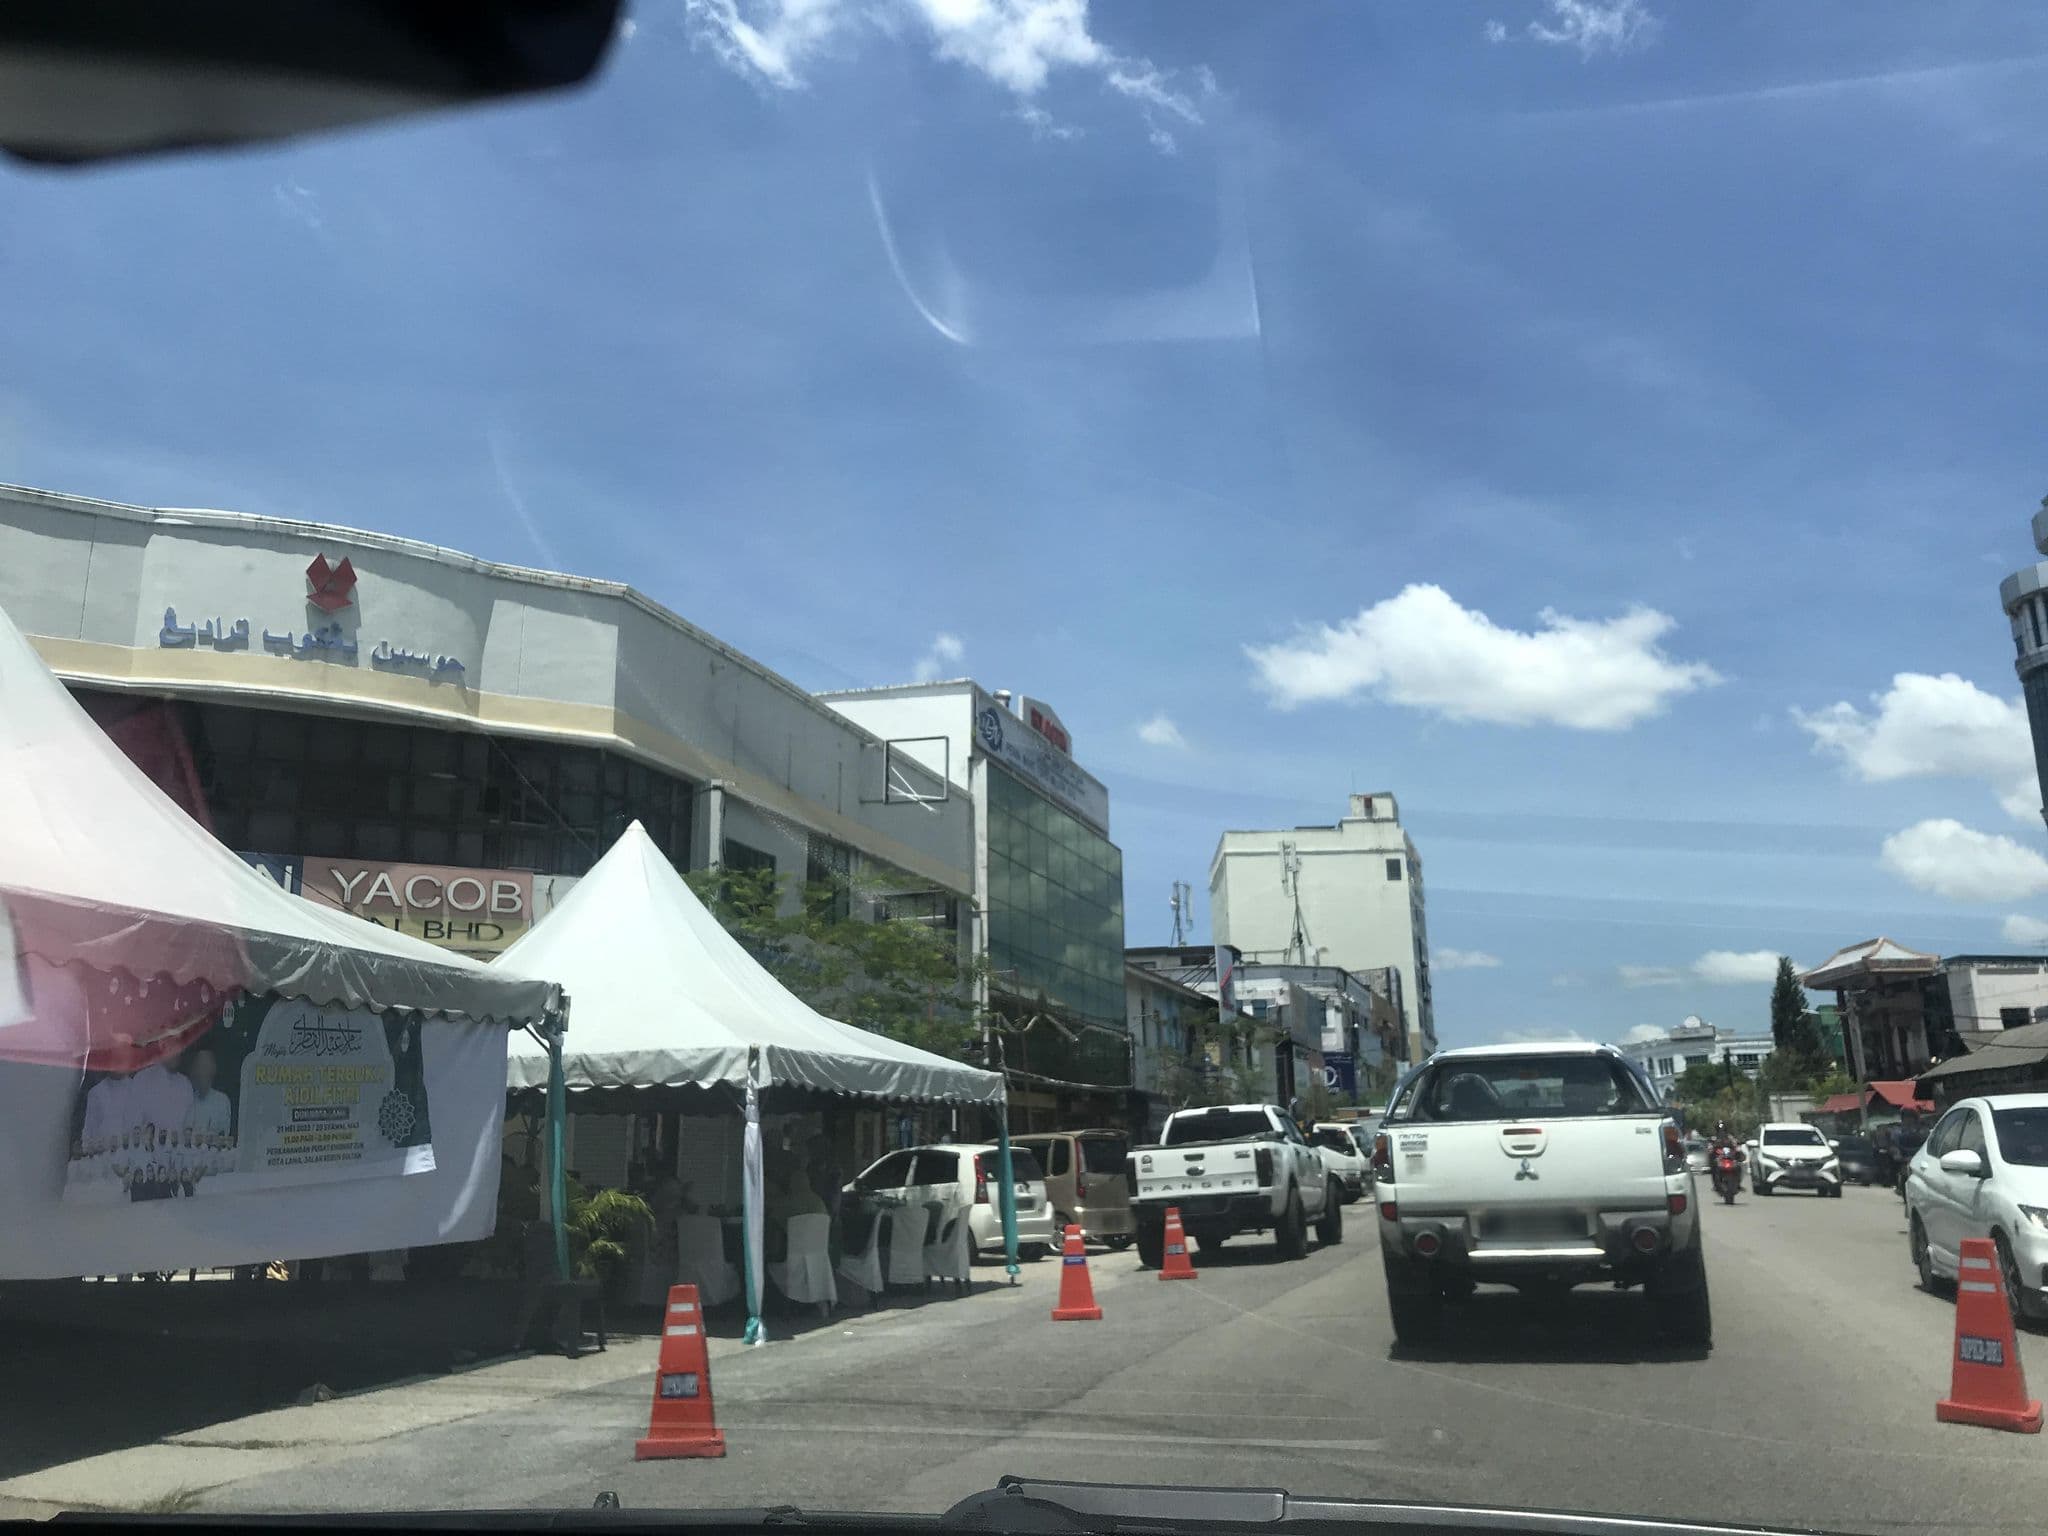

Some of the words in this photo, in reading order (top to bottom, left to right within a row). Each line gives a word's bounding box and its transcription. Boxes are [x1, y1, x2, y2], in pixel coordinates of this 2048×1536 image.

[328, 865, 524, 914] YACOB
[422, 919, 504, 942] BHD
[1142, 1178, 1254, 1193] RANGER
